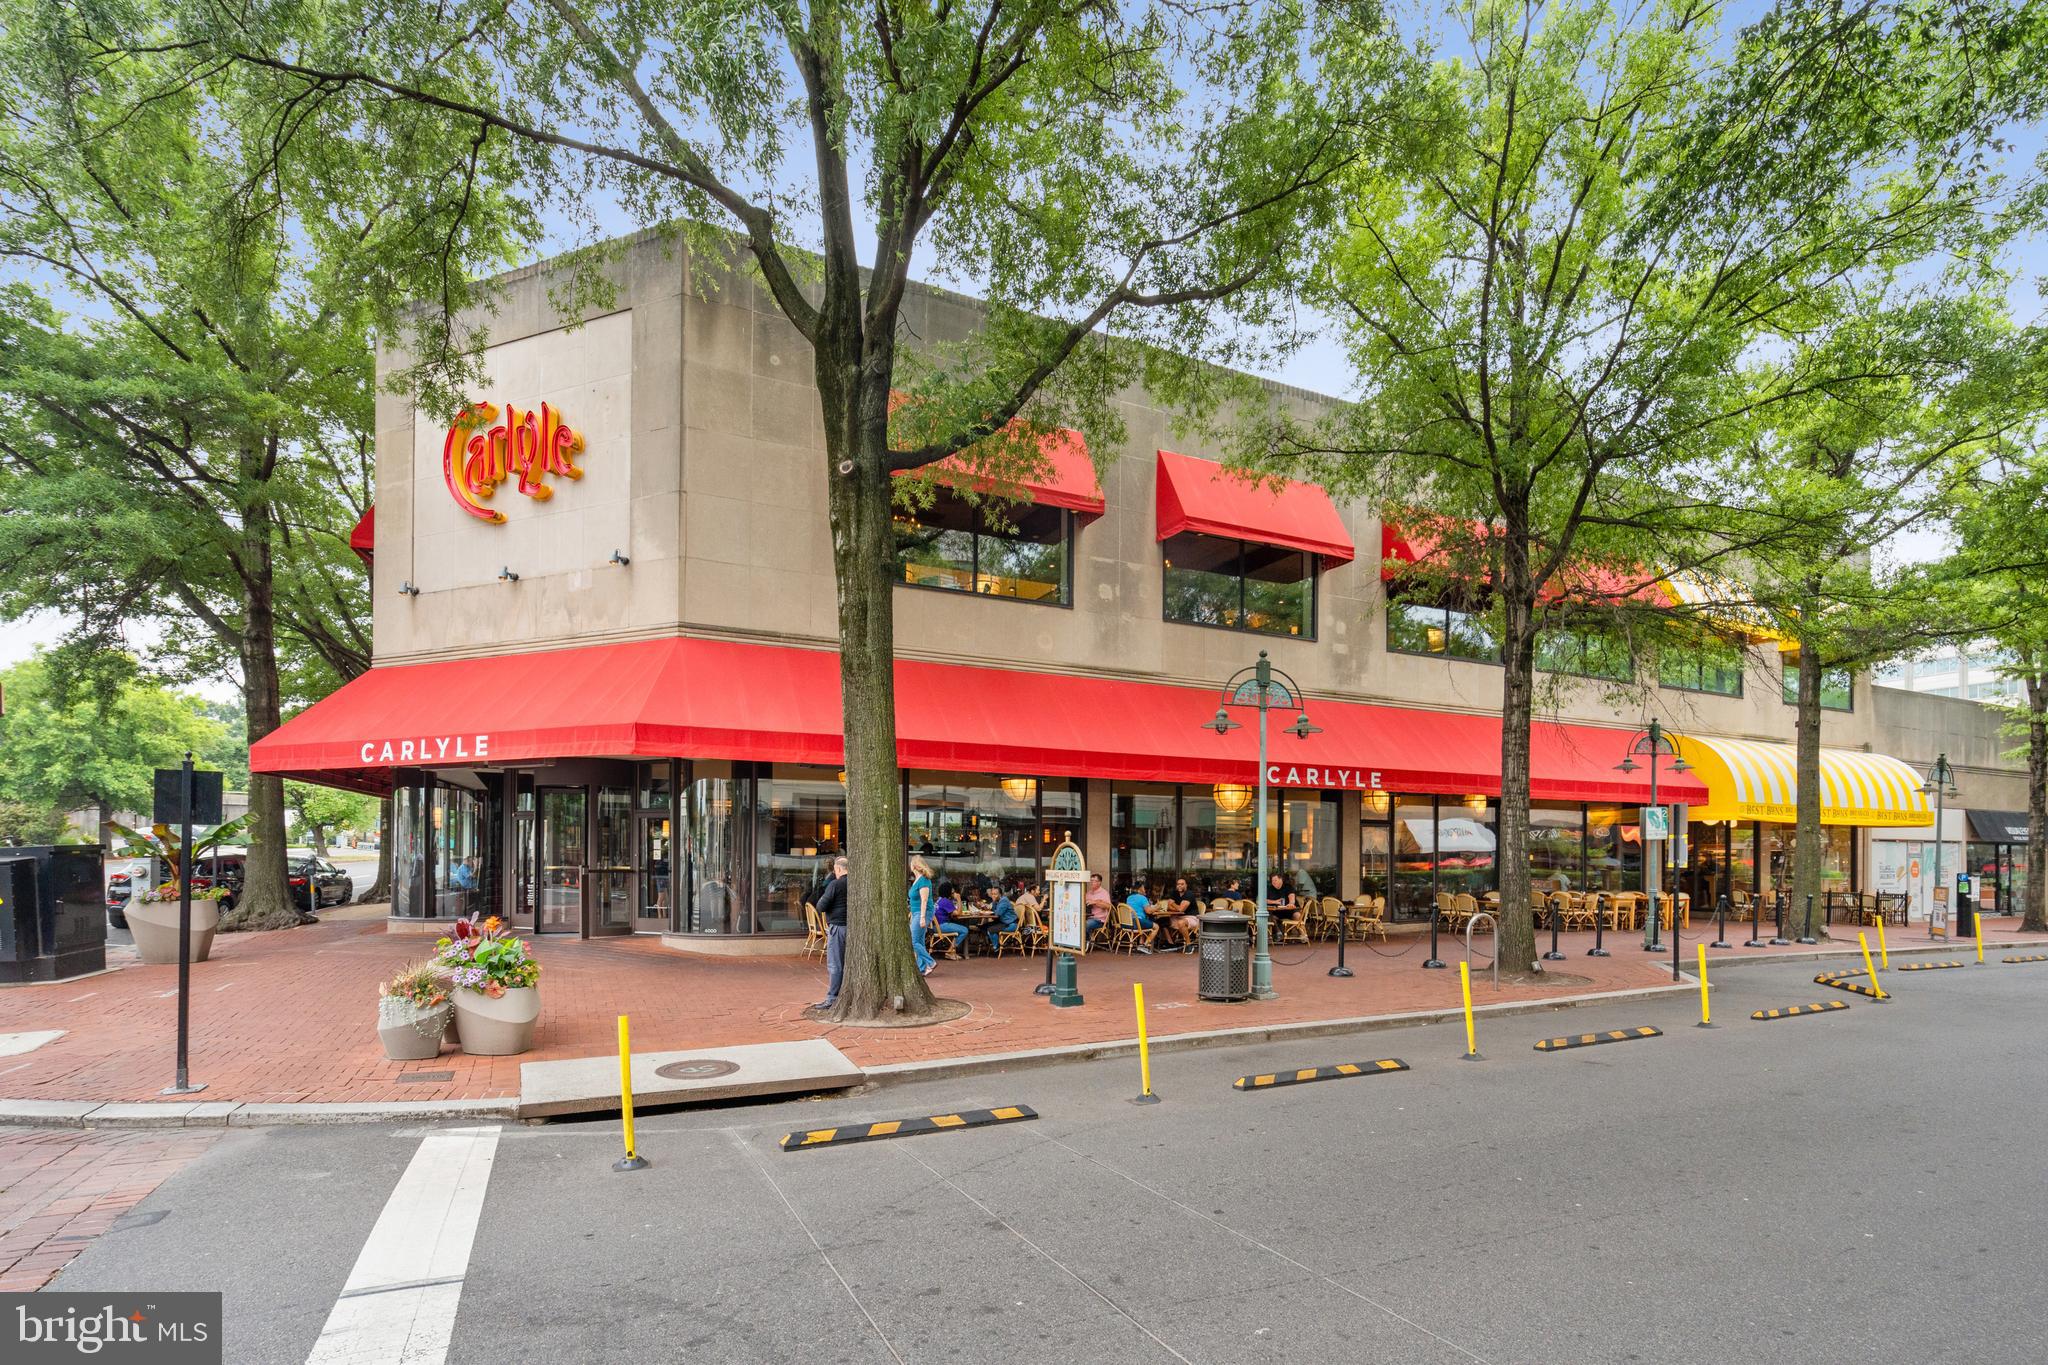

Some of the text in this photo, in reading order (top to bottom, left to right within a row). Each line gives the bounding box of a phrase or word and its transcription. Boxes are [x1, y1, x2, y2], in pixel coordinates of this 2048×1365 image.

[443, 401, 585, 524] Carlyle
[361, 736, 488, 763] CARLYLE
[1267, 766, 1382, 788] CARLYLE
